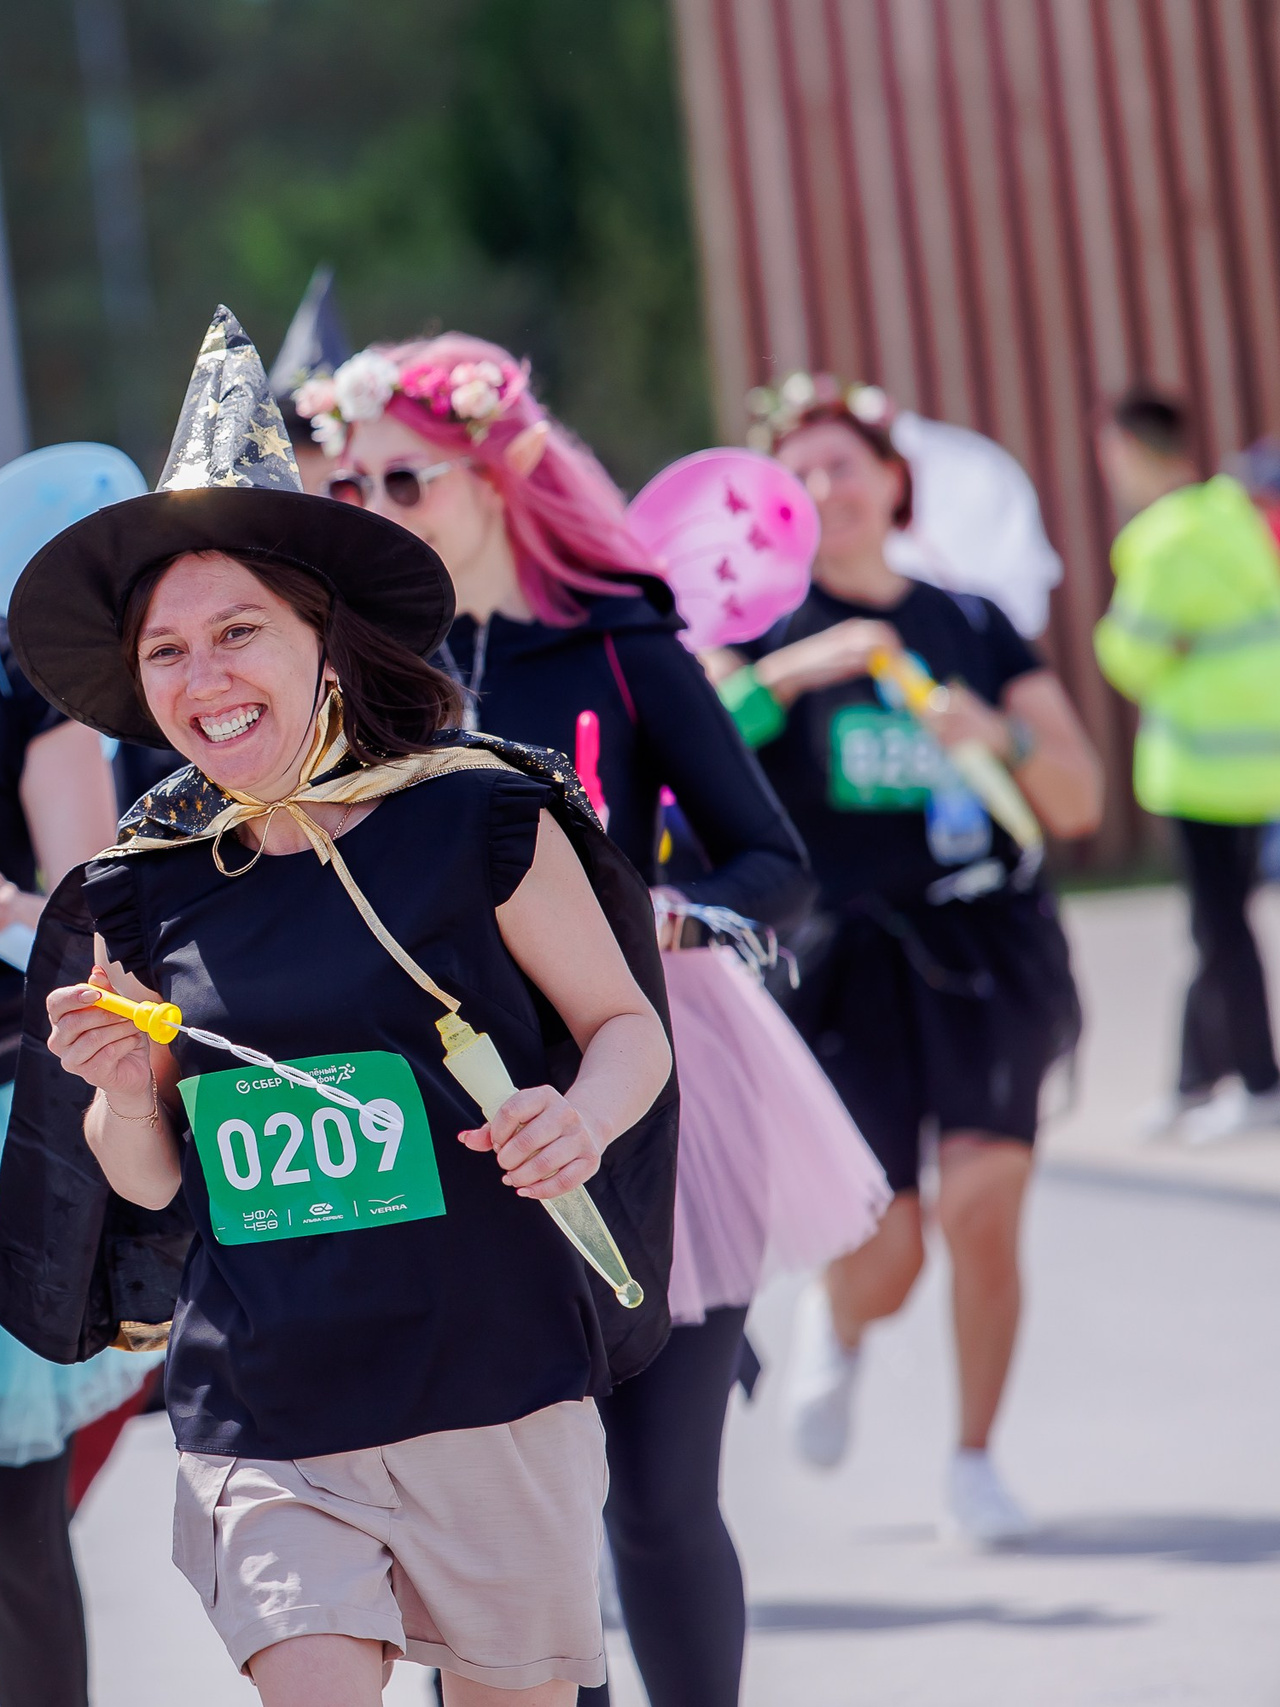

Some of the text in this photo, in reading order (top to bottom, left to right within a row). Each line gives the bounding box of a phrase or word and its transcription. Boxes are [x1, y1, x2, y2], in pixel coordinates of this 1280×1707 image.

[305, 1065, 338, 1077] лёный
[252, 1077, 283, 1090] СБЕР
[217, 1098, 405, 1191] 0209
[369, 1203, 408, 1215] VERRA
